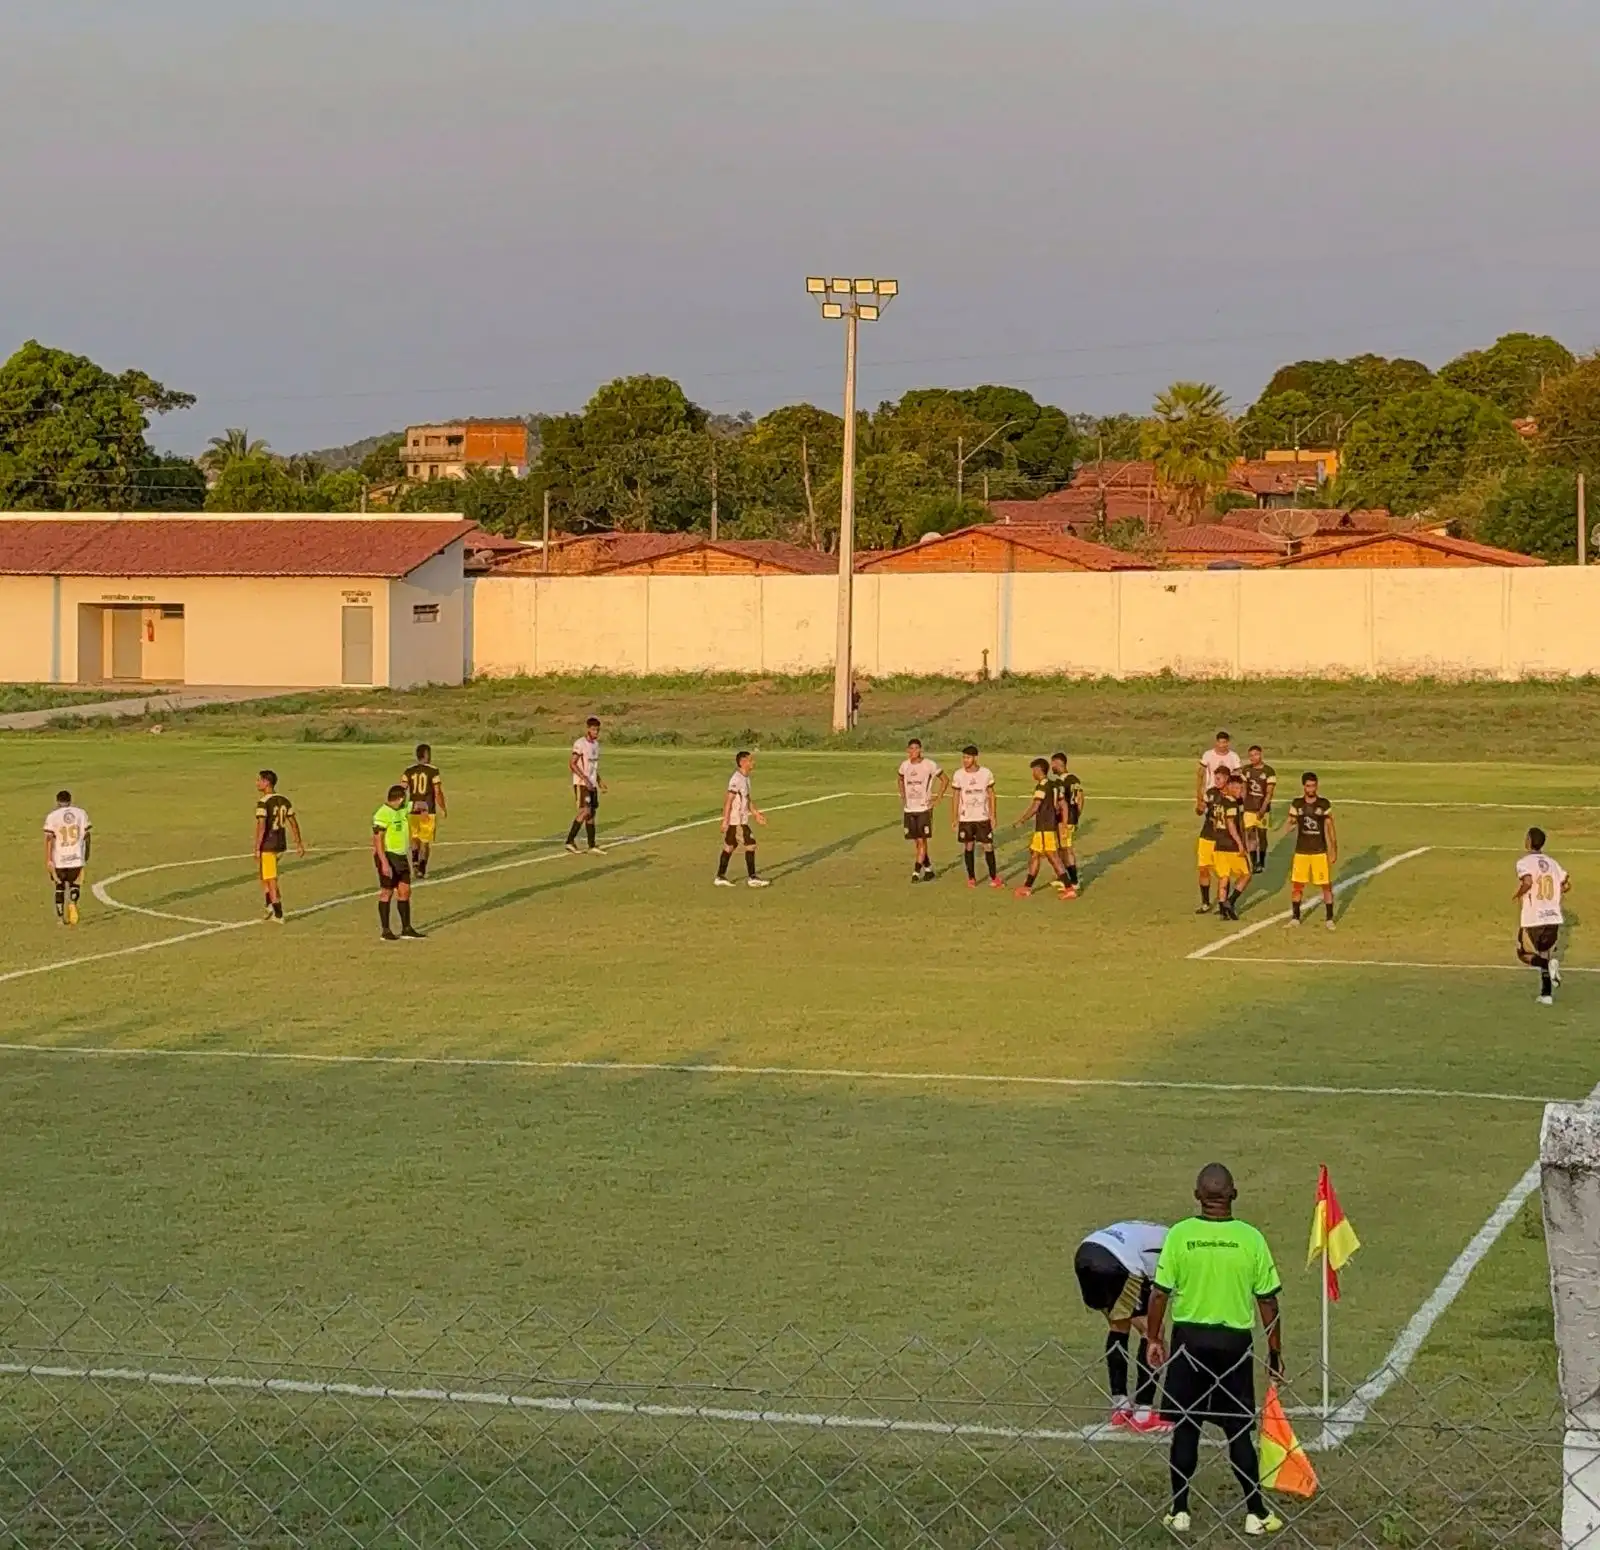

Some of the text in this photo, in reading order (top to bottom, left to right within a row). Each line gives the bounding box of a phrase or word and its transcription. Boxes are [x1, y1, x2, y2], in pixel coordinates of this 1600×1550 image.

[411, 772, 428, 796] 10
[272, 804, 288, 831] 20
[58, 824, 81, 848] 19
[1536, 875, 1554, 901] 10
